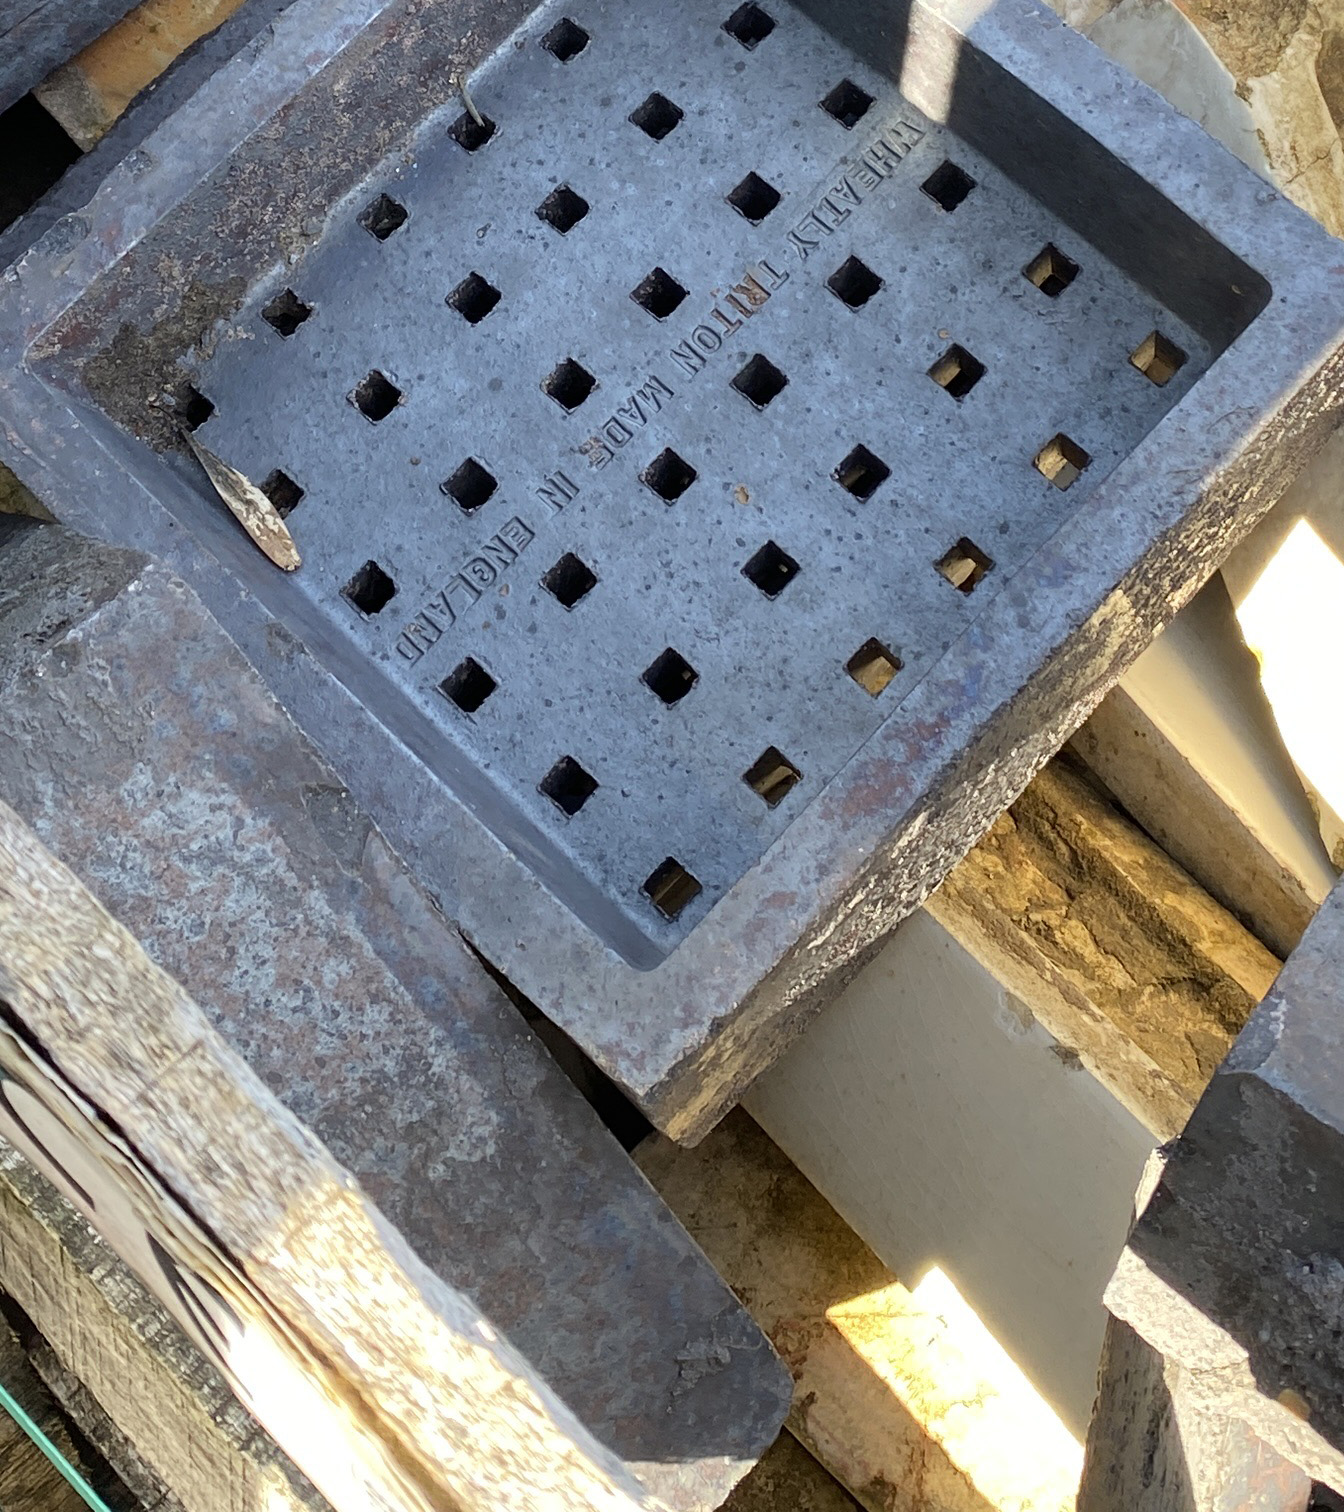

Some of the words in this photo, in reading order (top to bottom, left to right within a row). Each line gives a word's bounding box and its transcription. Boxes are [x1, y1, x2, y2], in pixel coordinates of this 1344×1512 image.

[786, 119, 927, 261] WHEATLY
[669, 259, 791, 379] TRITON
[578, 374, 676, 471] MADE
[535, 470, 581, 518] IN
[395, 515, 536, 668] ENGLAND
